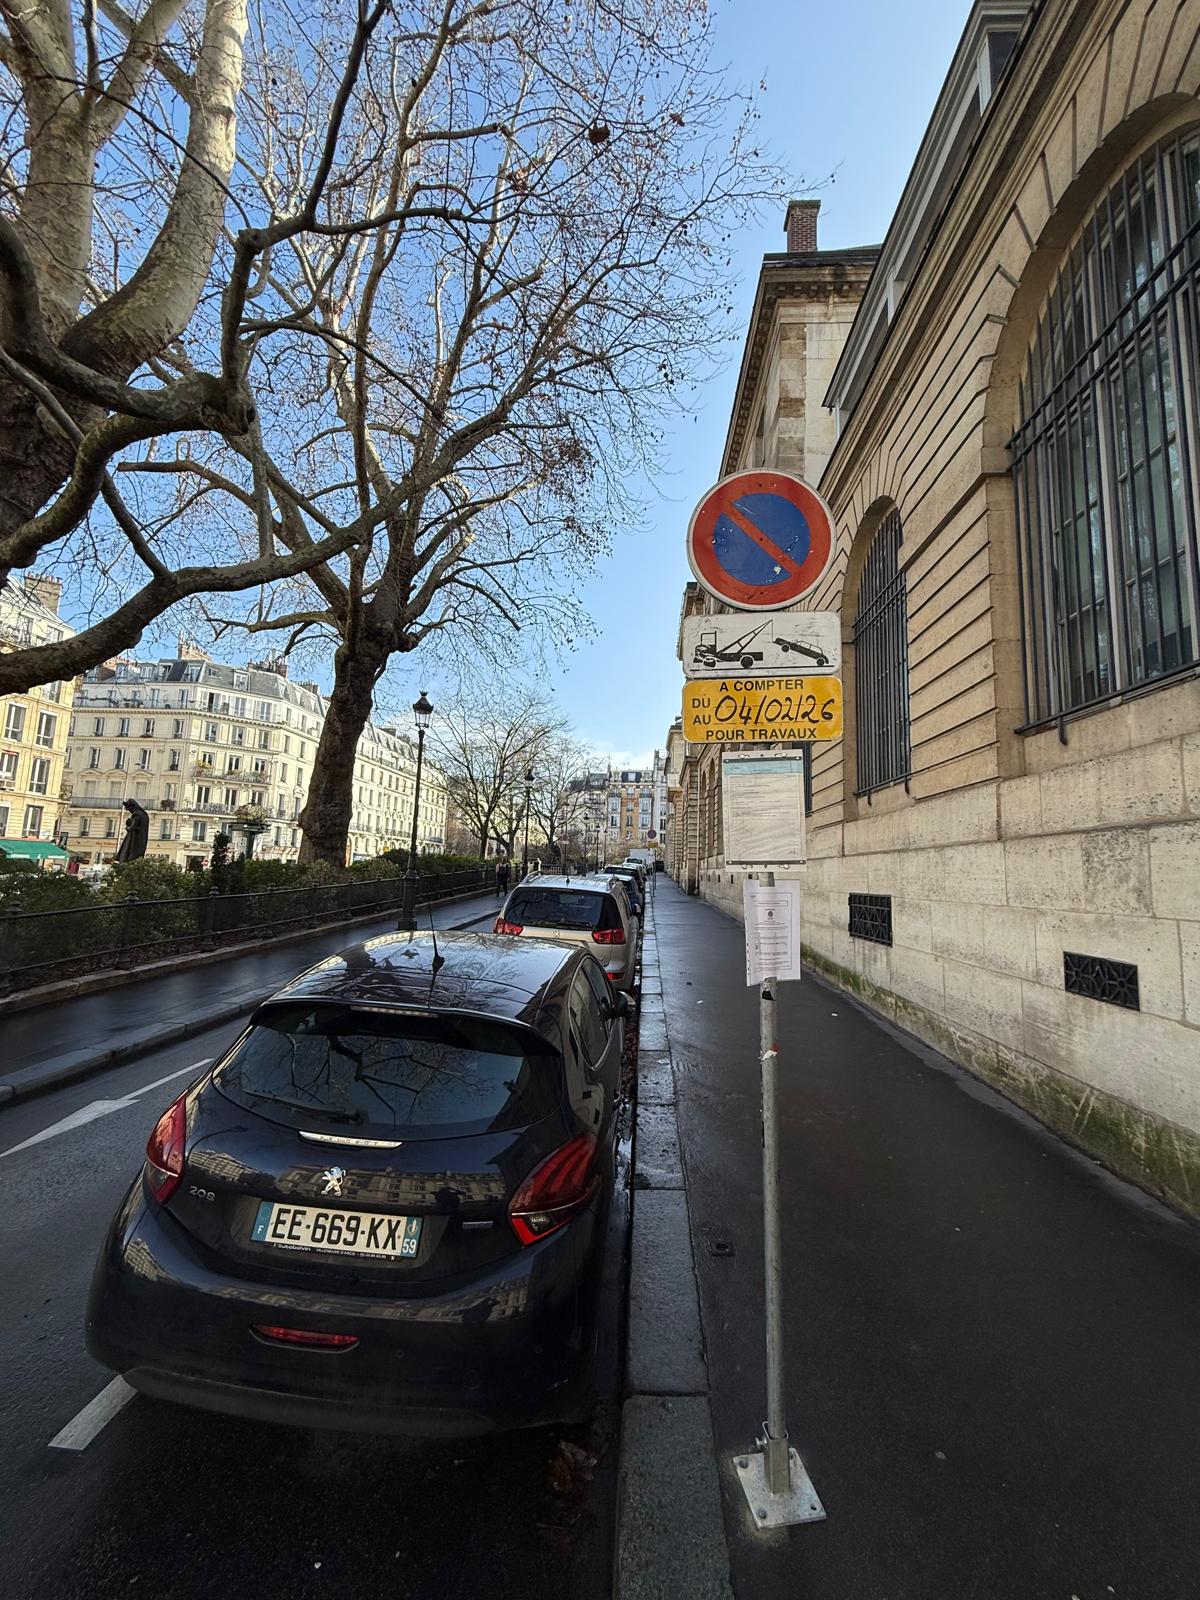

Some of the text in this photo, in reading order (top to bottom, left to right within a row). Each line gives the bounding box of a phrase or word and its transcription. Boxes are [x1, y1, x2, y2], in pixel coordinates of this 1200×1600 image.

[719, 679, 804, 692] A COMPTER
[692, 697, 710, 709] DU
[714, 694, 835, 726] 04/02/26
[693, 714, 711, 725] AU
[706, 728, 817, 740] POUR TRAVAUX
[188, 1185, 216, 1202] 208
[257, 1225, 264, 1234] F
[402, 1238, 417, 1254] 59
